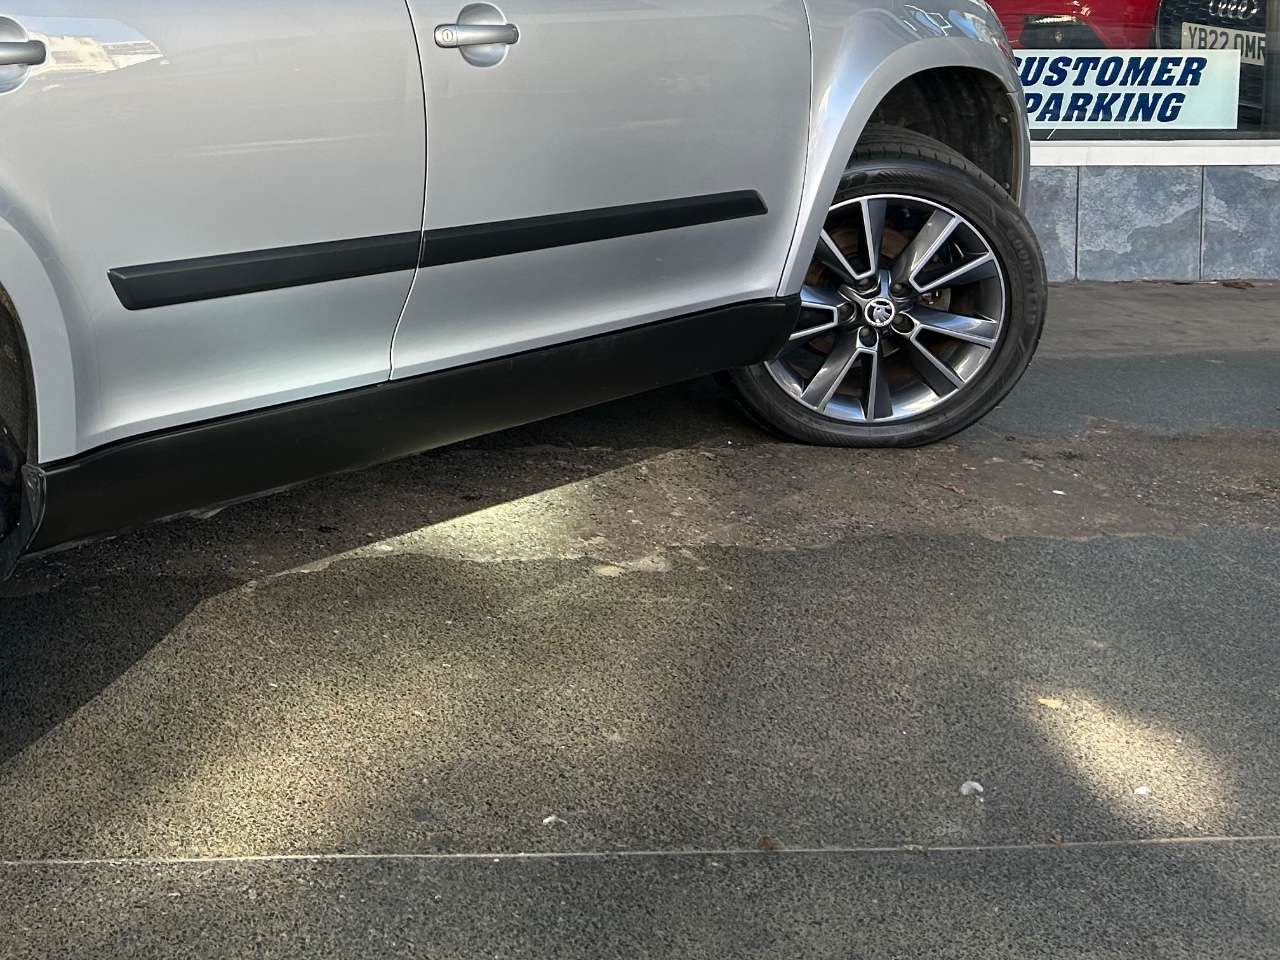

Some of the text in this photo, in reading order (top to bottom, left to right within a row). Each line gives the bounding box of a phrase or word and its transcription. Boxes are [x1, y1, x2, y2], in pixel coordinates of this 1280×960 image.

[1188, 25, 1230, 50] YB22
[1014, 56, 1207, 87] USTOMER
[1025, 92, 1187, 123] PARKING
